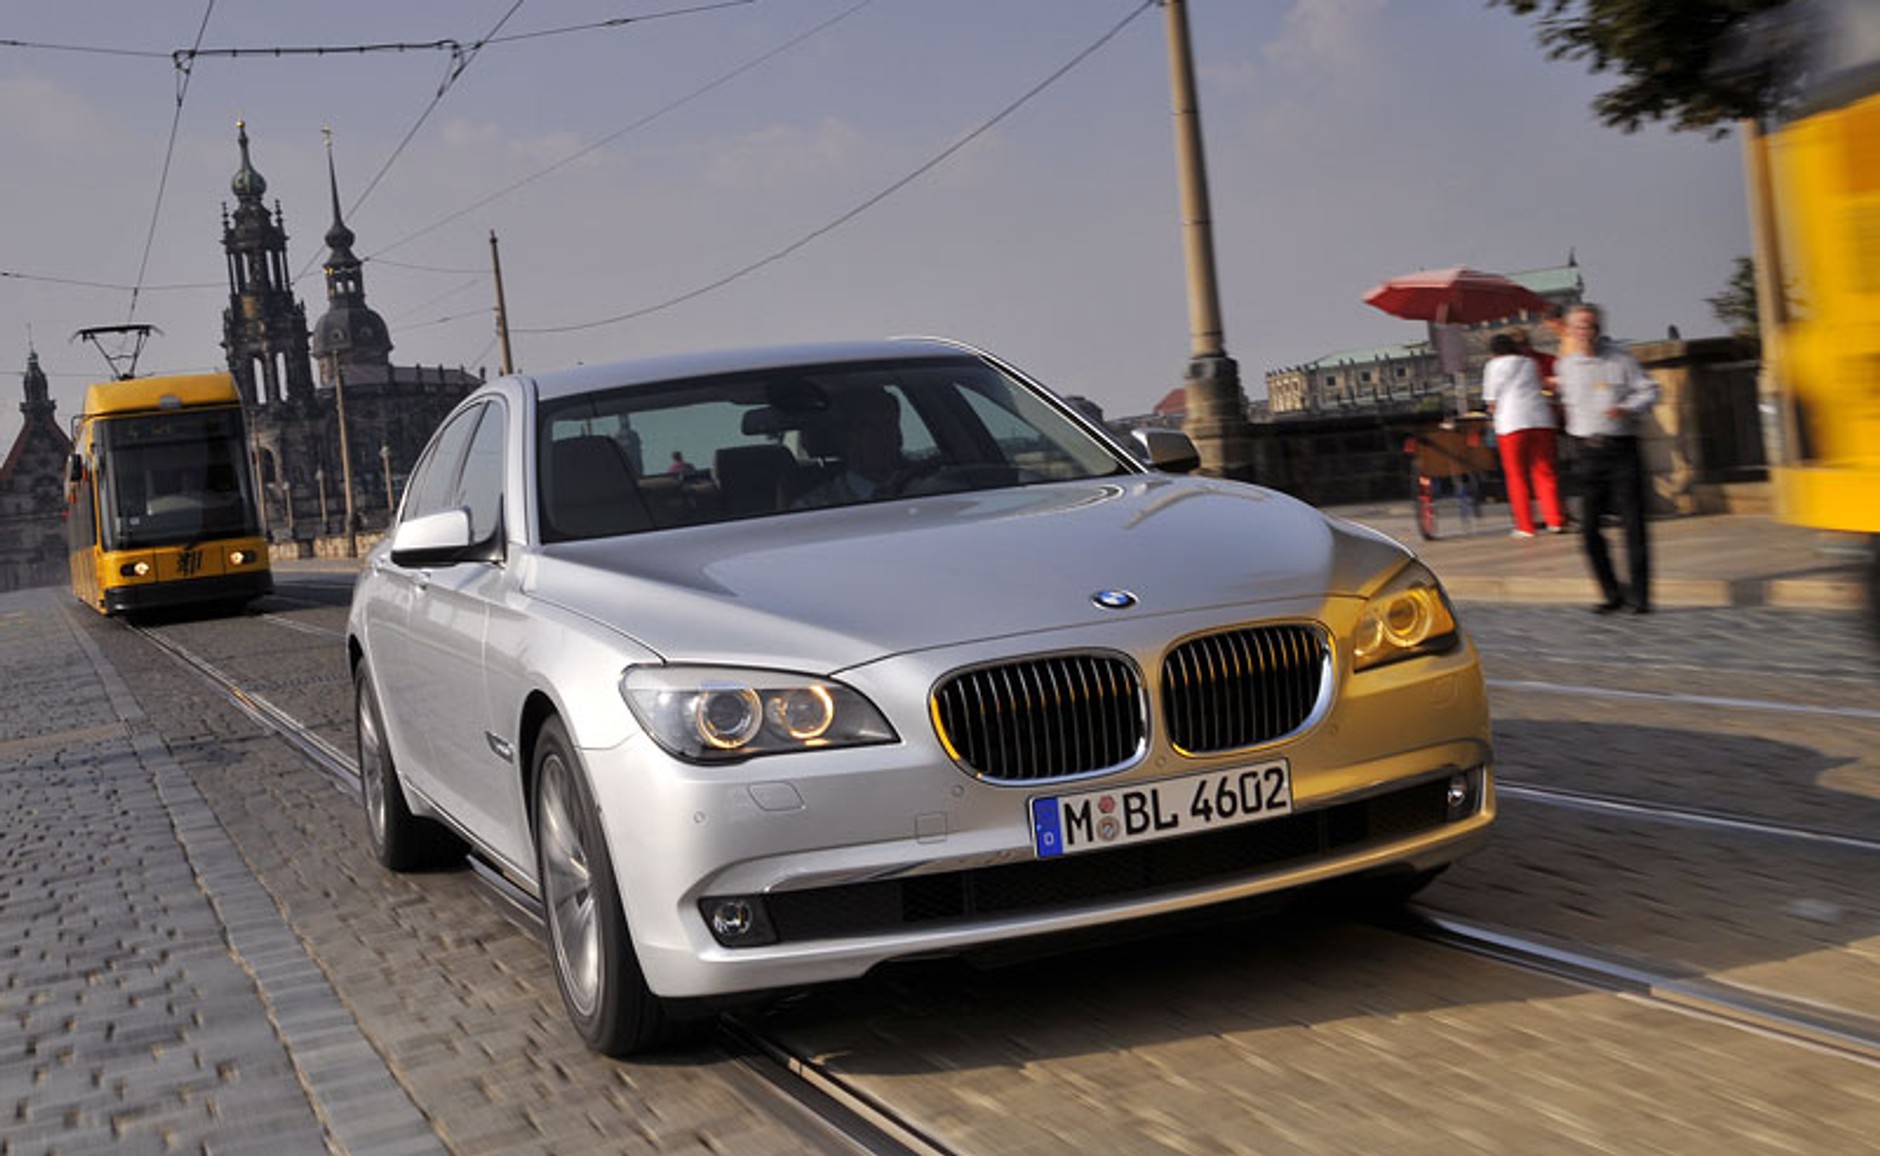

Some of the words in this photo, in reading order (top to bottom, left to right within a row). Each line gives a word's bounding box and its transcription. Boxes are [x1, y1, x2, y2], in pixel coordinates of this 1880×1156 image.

[1064, 800, 1093, 845] M
[1123, 789, 1178, 834] BL
[1190, 767, 1287, 821] 4602
